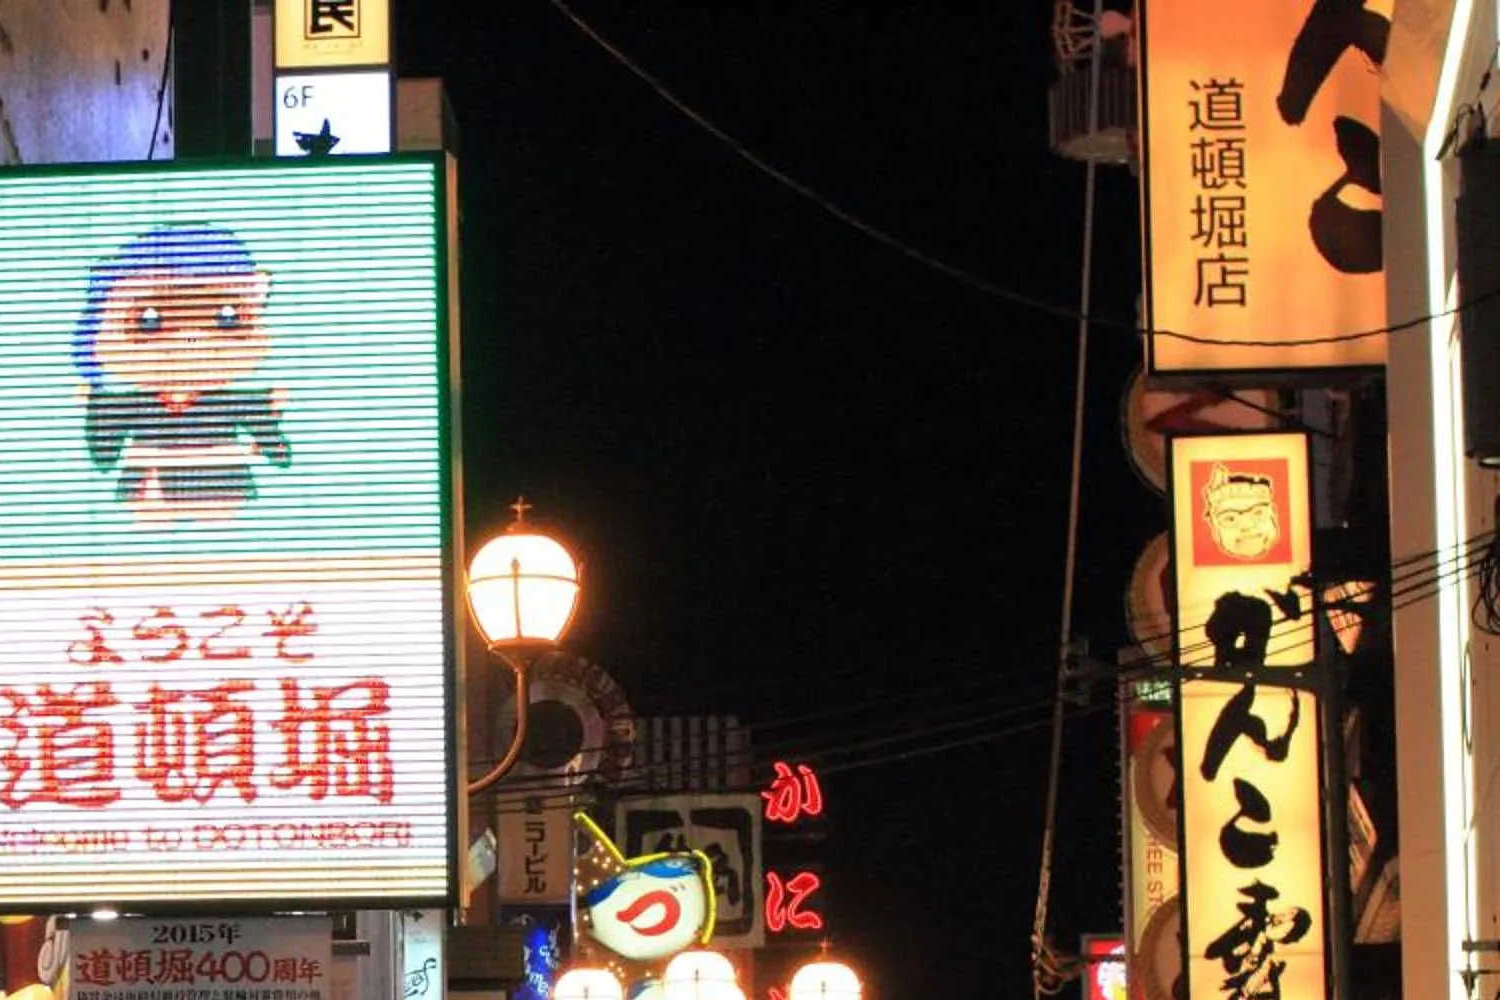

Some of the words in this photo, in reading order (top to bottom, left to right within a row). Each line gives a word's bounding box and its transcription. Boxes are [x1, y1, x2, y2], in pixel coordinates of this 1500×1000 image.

[283, 85, 315, 109] 6F
[1187, 77, 1248, 308] 道頓堀店
[67, 602, 321, 665] ようこそ
[145, 826, 182, 852] to
[195, 821, 412, 849] DOTONBORI
[153, 923, 242, 945] 2015年
[75, 948, 323, 987] 道頓堀400周年
